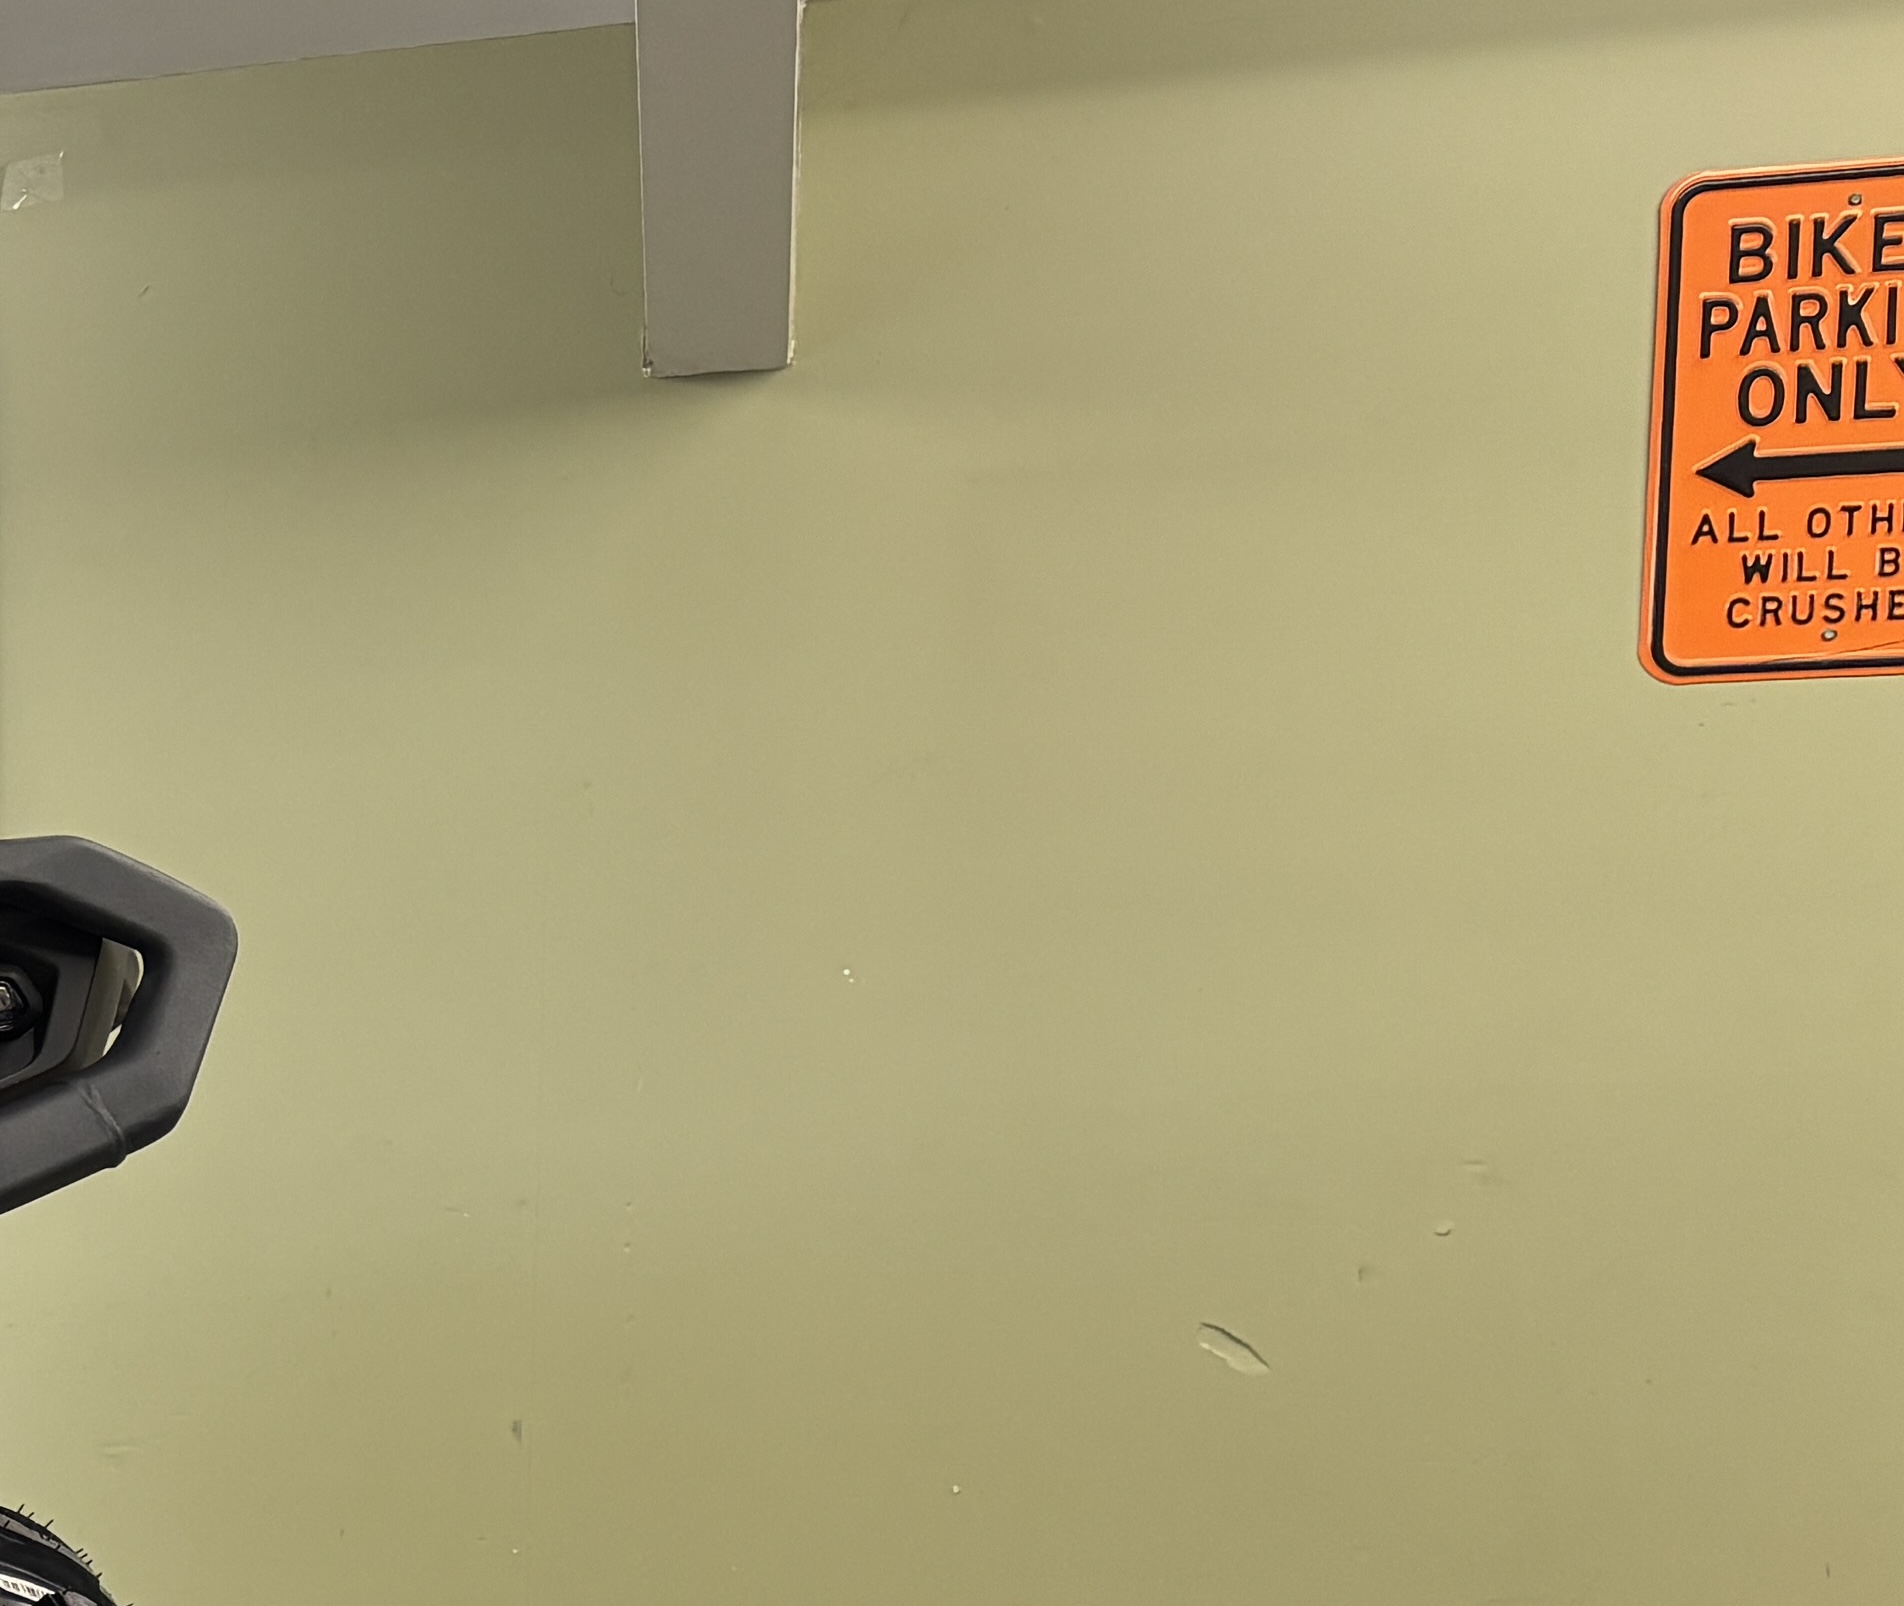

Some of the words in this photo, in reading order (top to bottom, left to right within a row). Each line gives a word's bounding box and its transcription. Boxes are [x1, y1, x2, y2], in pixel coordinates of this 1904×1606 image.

[1700, 287, 1897, 359] PARKI
[1738, 357, 1904, 426] ONL
[1691, 510, 1779, 545] ALL
[1807, 502, 1904, 537] OTH
[1742, 550, 1848, 584] WILL
